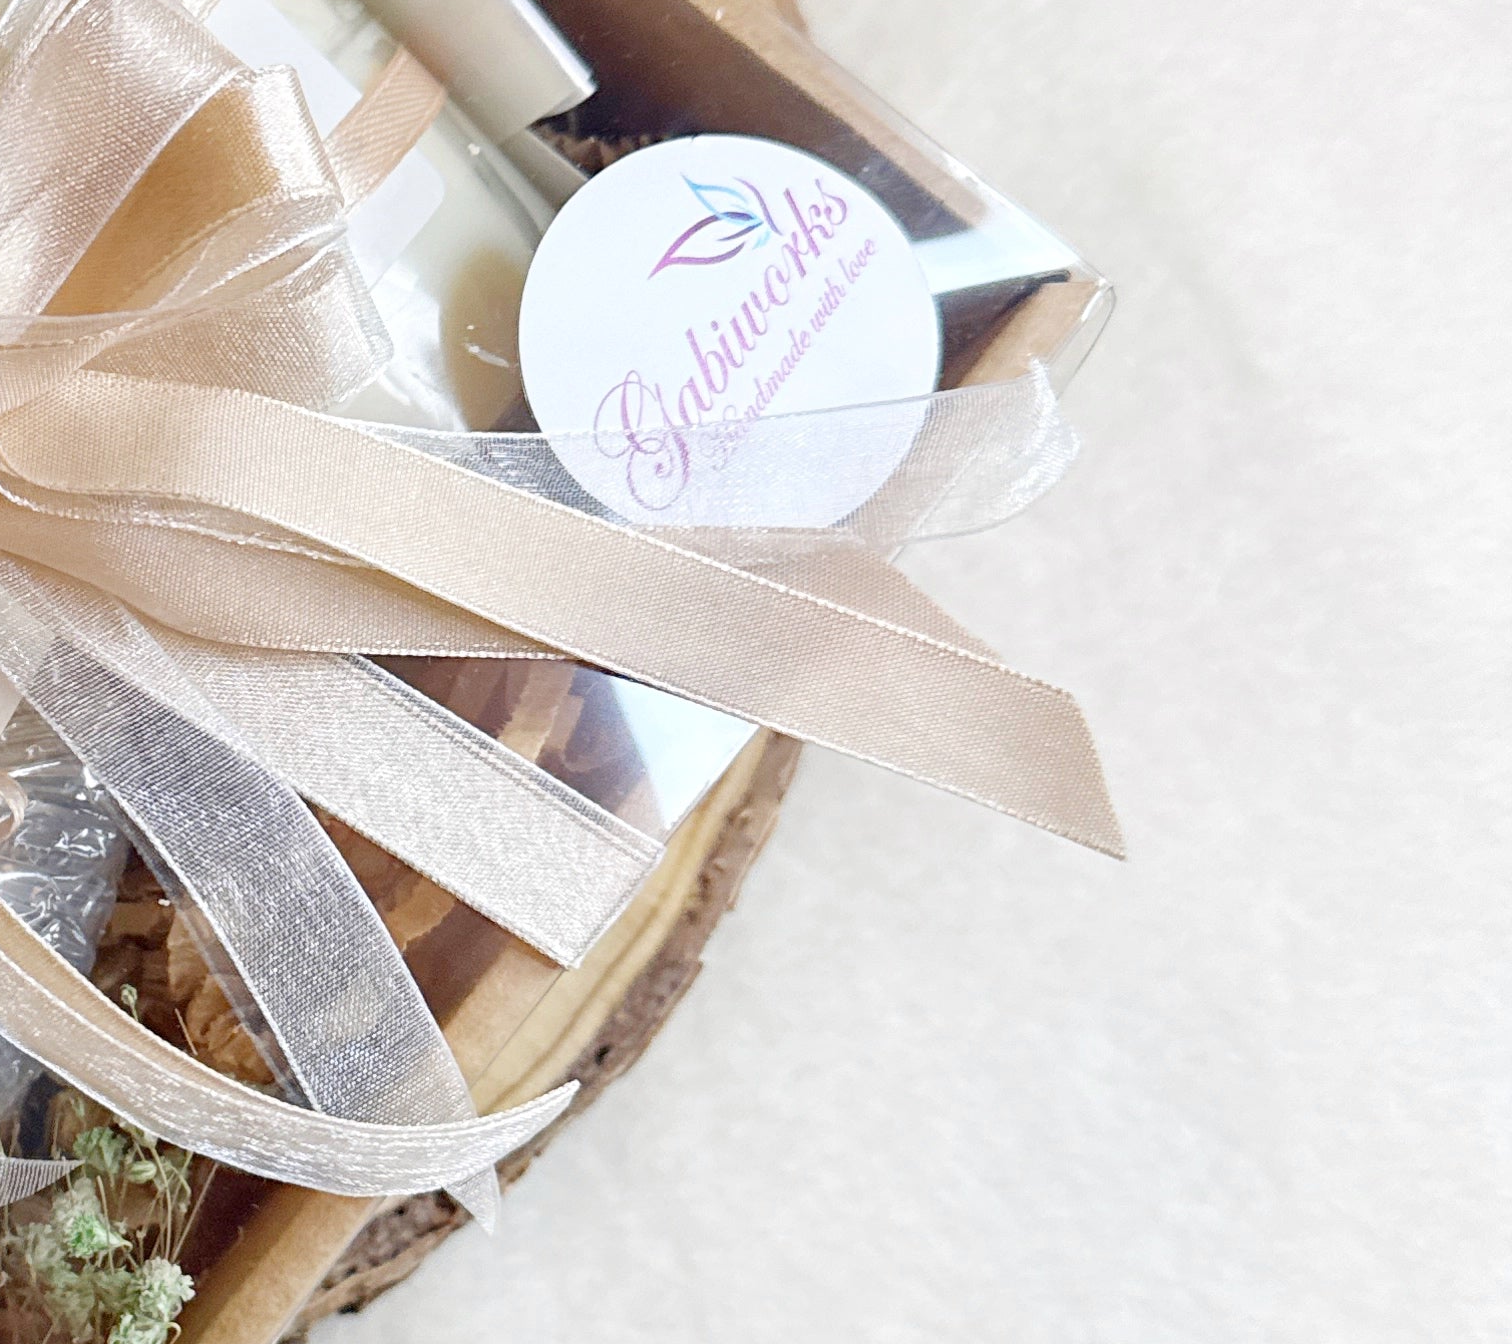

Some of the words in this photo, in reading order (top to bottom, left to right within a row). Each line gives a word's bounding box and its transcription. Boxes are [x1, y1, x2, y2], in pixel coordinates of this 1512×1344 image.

[592, 177, 849, 511] Gabiworks
[810, 277, 846, 333] with
[838, 238, 876, 284] love
